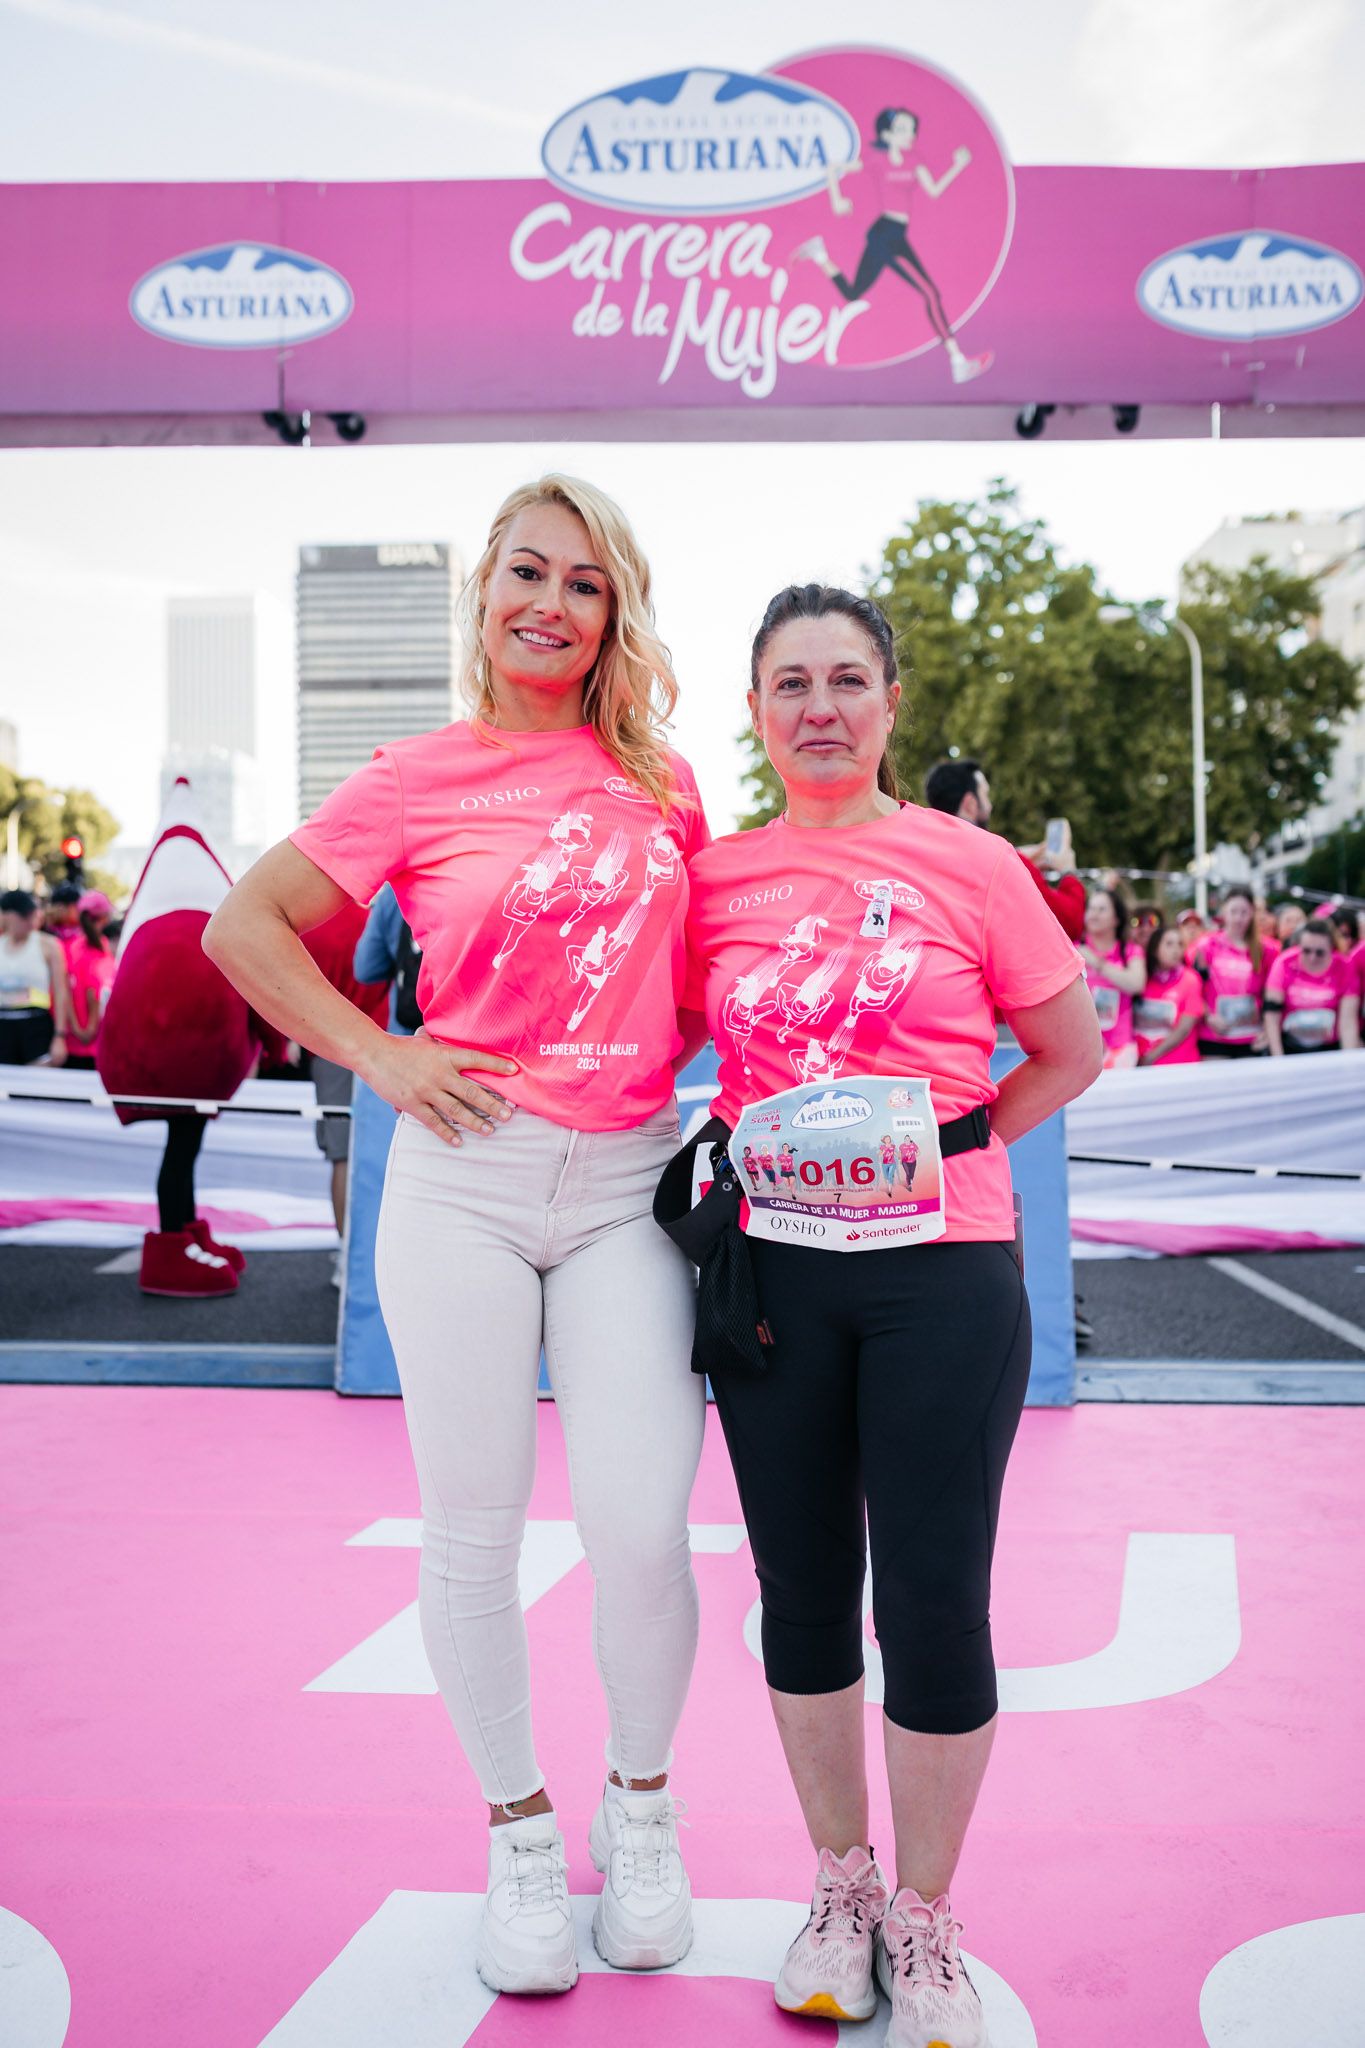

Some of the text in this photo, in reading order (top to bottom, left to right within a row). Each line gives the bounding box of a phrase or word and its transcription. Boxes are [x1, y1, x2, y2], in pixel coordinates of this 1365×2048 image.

[566, 124, 829, 174] ASTURIANA
[509, 202, 773, 281] Carrera
[151, 284, 332, 319] ASTURIANA
[1159, 272, 1344, 310] ASTURIANA
[572, 269, 871, 399] de la Mujer
[460, 786, 541, 810] OYSHO
[728, 884, 793, 913] OYSHO
[539, 1043, 639, 1056] CARRERA DE LA MUJER
[576, 1057, 601, 1071] 2024
[795, 1106, 868, 1126] ASTURIANA
[799, 1157, 876, 1186] 016
[769, 1199, 919, 1220] CARRERA DE LA MUJER MADRID
[833, 1193, 842, 1204] 7
[770, 1216, 826, 1238] OYSHO
[862, 1223, 922, 1240] Santander
